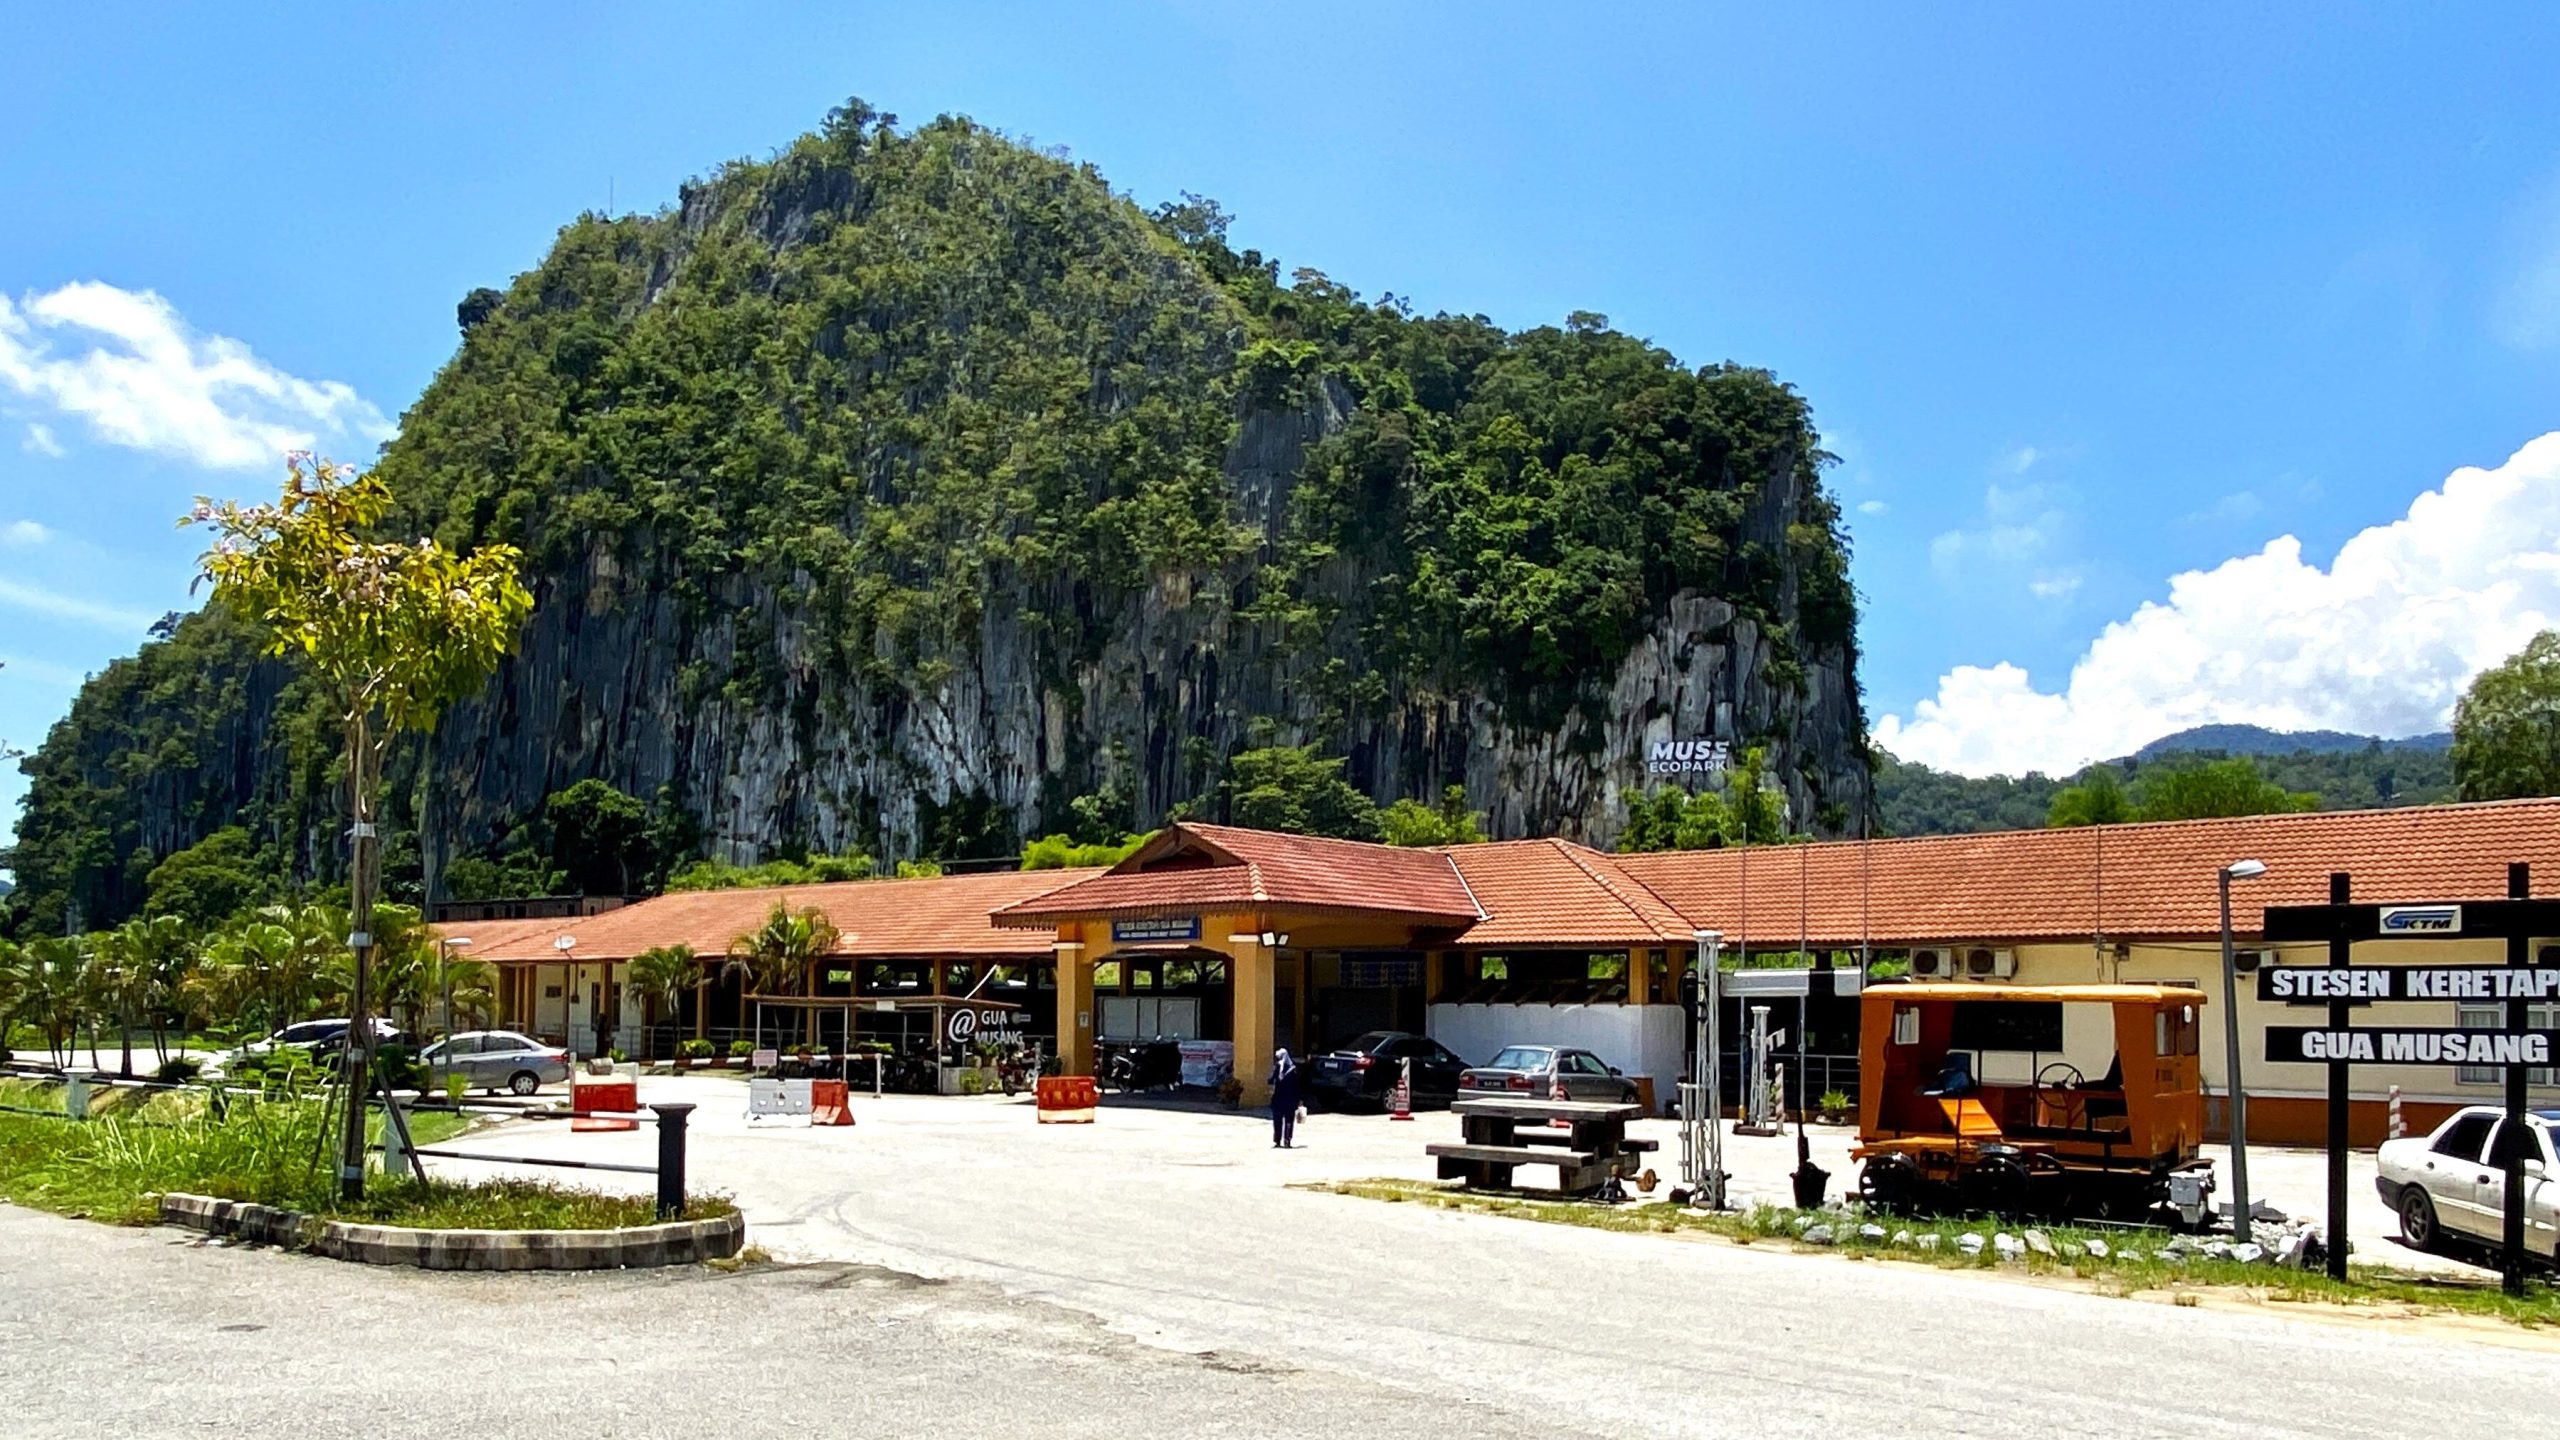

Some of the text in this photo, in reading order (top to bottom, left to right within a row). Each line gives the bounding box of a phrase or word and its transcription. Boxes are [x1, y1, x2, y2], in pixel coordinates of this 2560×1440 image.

[1652, 741, 1730, 760] MUSE
[1650, 761, 1726, 772] ECOPARK
[2403, 919, 2452, 929] KTM
[2272, 969, 2560, 997] STESEN KERETAP
[981, 1010, 1008, 1025] GUA
[975, 1030, 1024, 1045] MUSANG
[2302, 1031, 2548, 1062] GUA MUSANG
